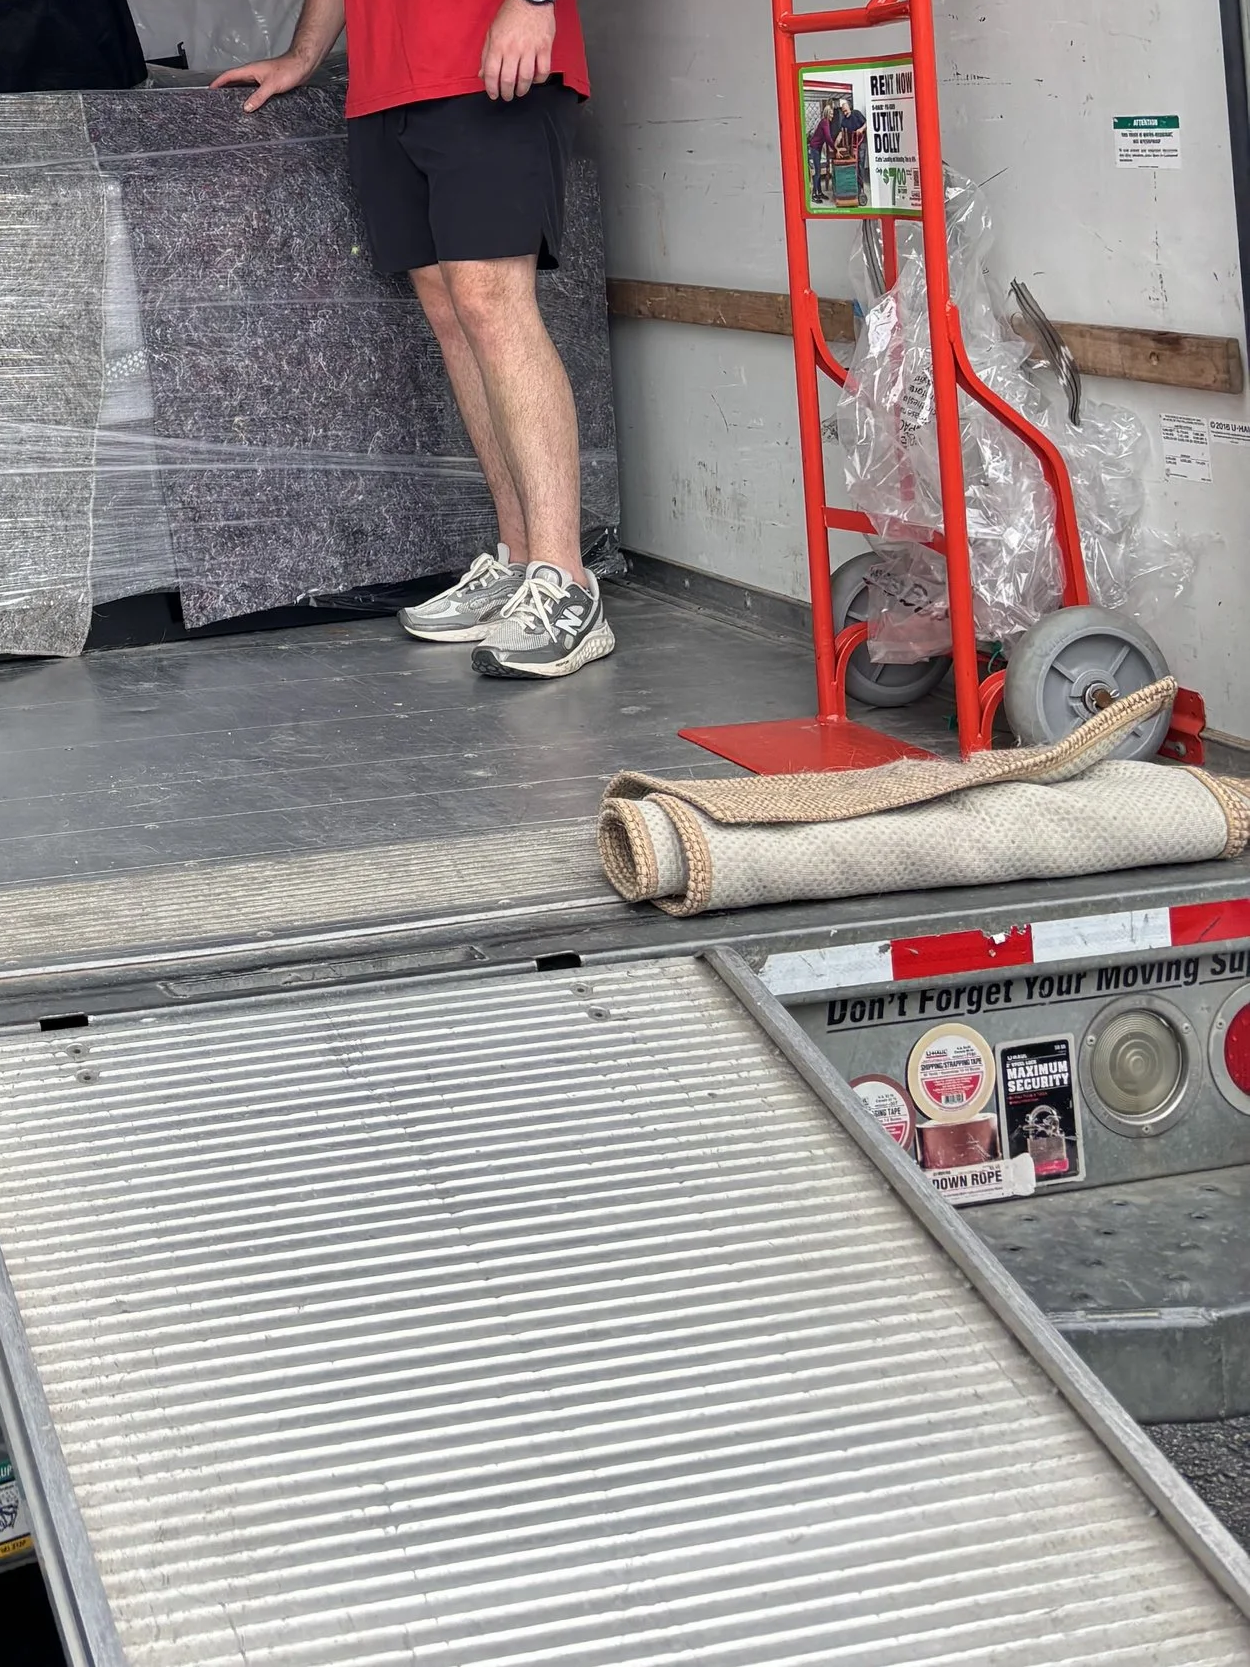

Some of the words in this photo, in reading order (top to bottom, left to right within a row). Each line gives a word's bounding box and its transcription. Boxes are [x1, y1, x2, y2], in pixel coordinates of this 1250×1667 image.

[870, 73, 894, 97] RENT
[895, 71, 913, 95] NOW
[872, 110, 904, 133] UTILITY
[874, 132, 900, 154] DOLLY
[827, 989, 908, 1027] Don't
[919, 979, 1013, 1016] Forget
[1025, 968, 1084, 1000] Your
[1096, 955, 1200, 989] Moving
[970, 1057, 982, 1065] TAPE
[1006, 1060, 1068, 1080] MAXIMUM
[1007, 1072, 1069, 1093] SECURITY
[888, 1107, 901, 1115] TAPE
[971, 1170, 1003, 1186] ROPE
